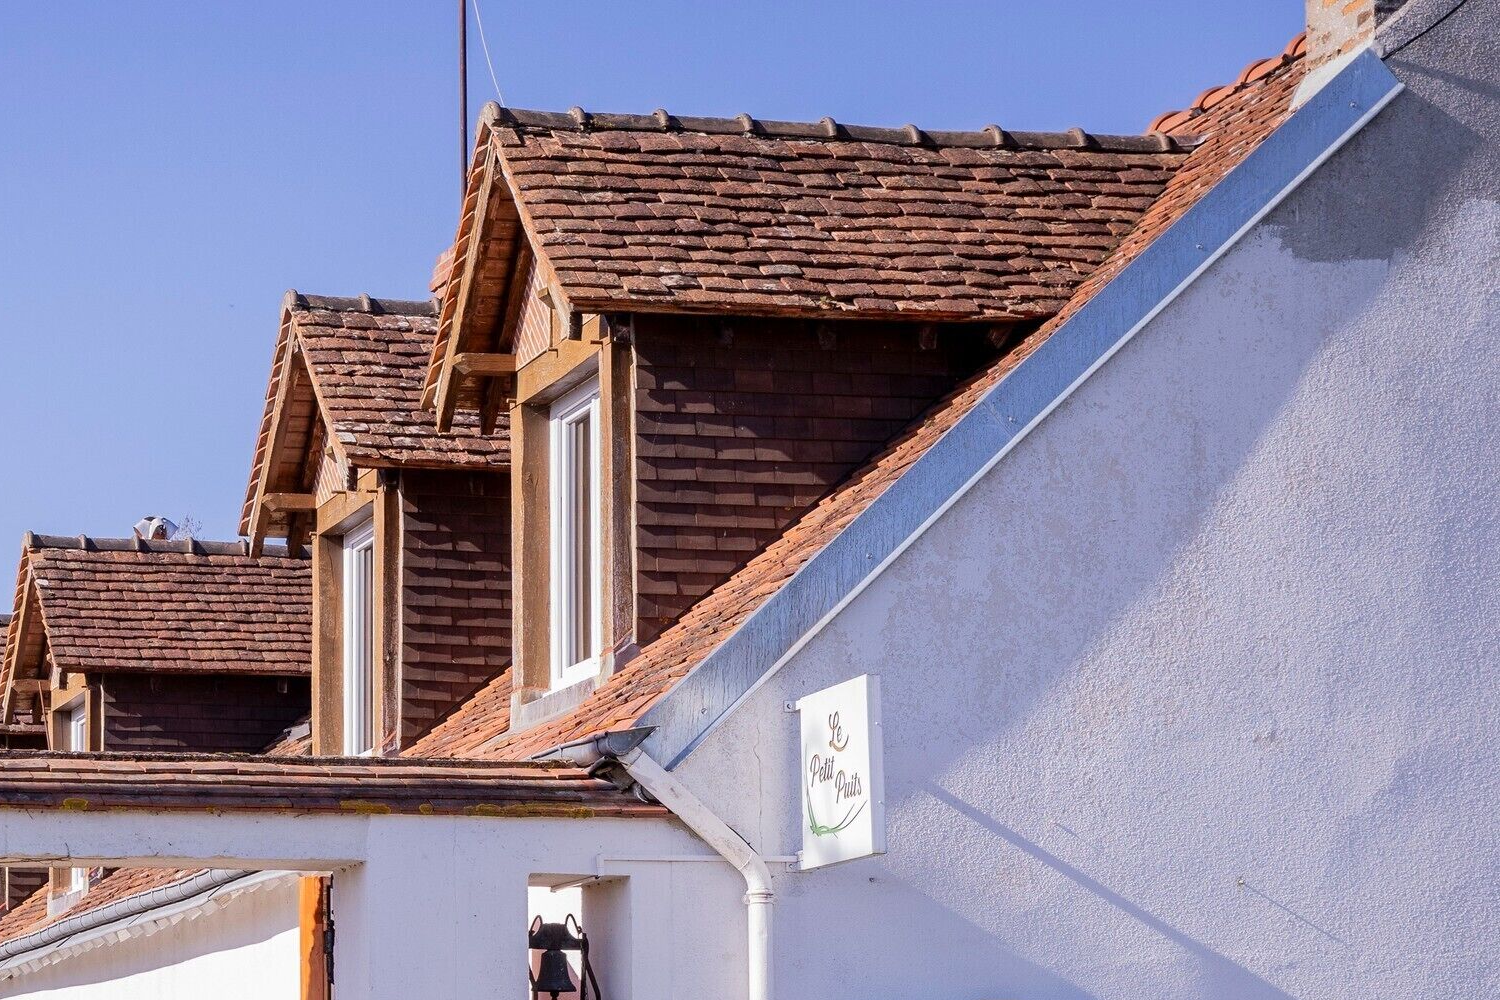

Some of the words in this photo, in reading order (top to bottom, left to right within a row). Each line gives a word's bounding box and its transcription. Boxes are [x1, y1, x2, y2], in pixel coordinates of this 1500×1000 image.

[829, 711, 849, 752] Le
[810, 753, 835, 788] Petit
[835, 769, 862, 804] Puits
